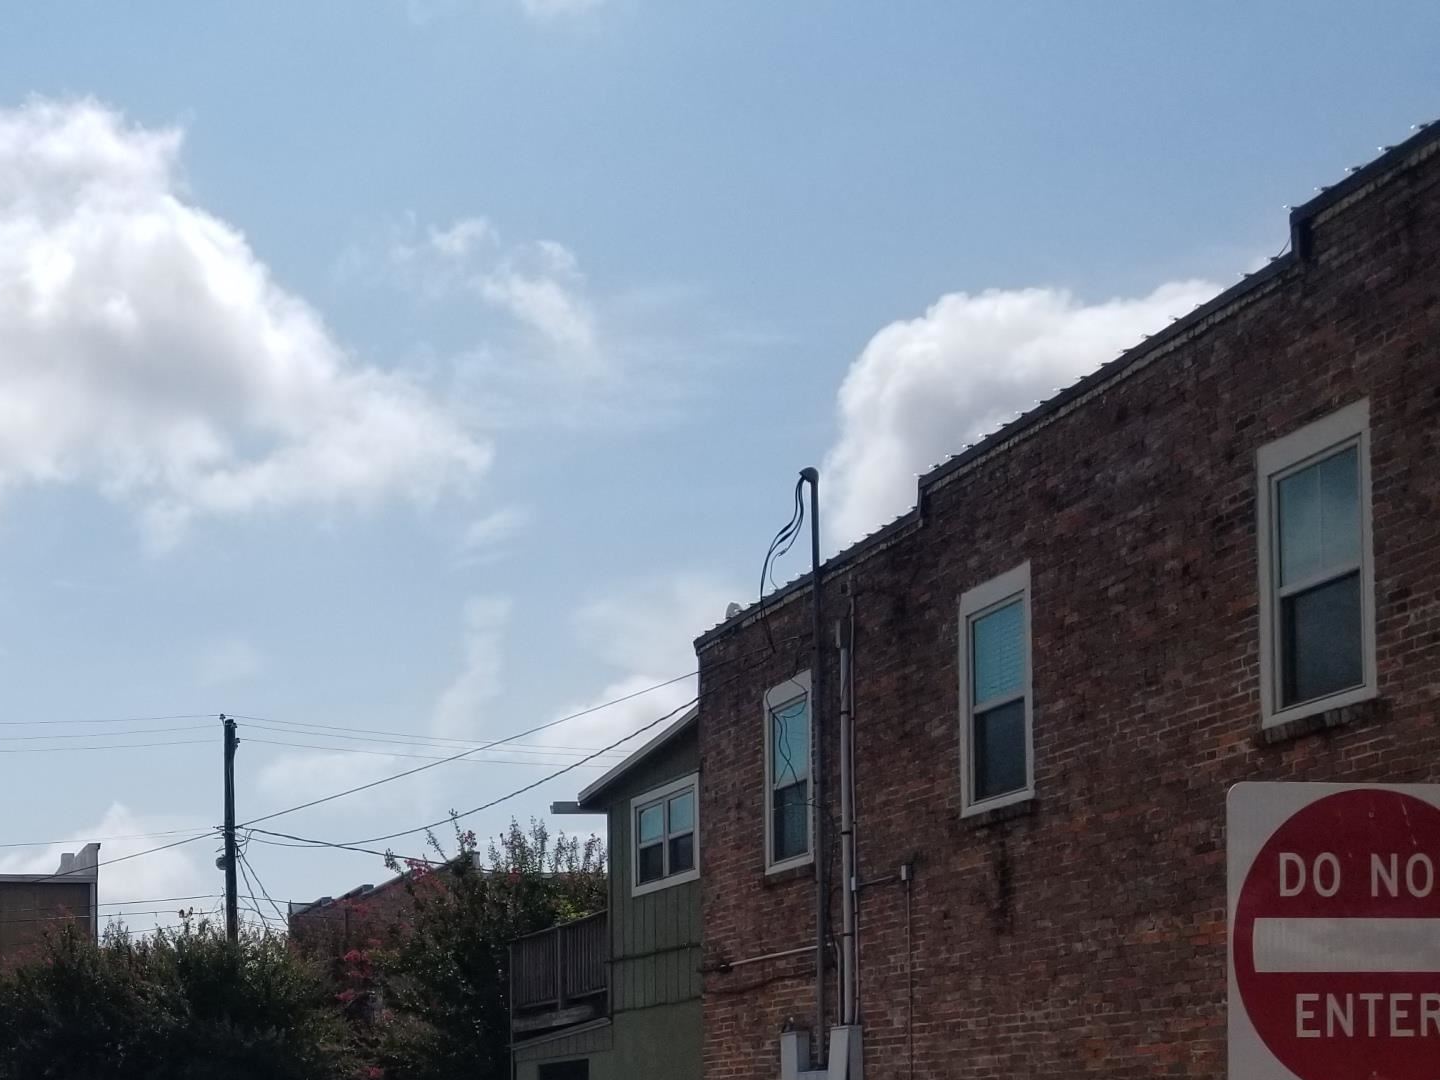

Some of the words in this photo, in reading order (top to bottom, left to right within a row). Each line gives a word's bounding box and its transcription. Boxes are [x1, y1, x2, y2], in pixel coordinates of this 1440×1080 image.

[1279, 852, 1341, 898] DO
[1370, 853, 1434, 898] NO
[1295, 993, 1440, 1038] ENTER
